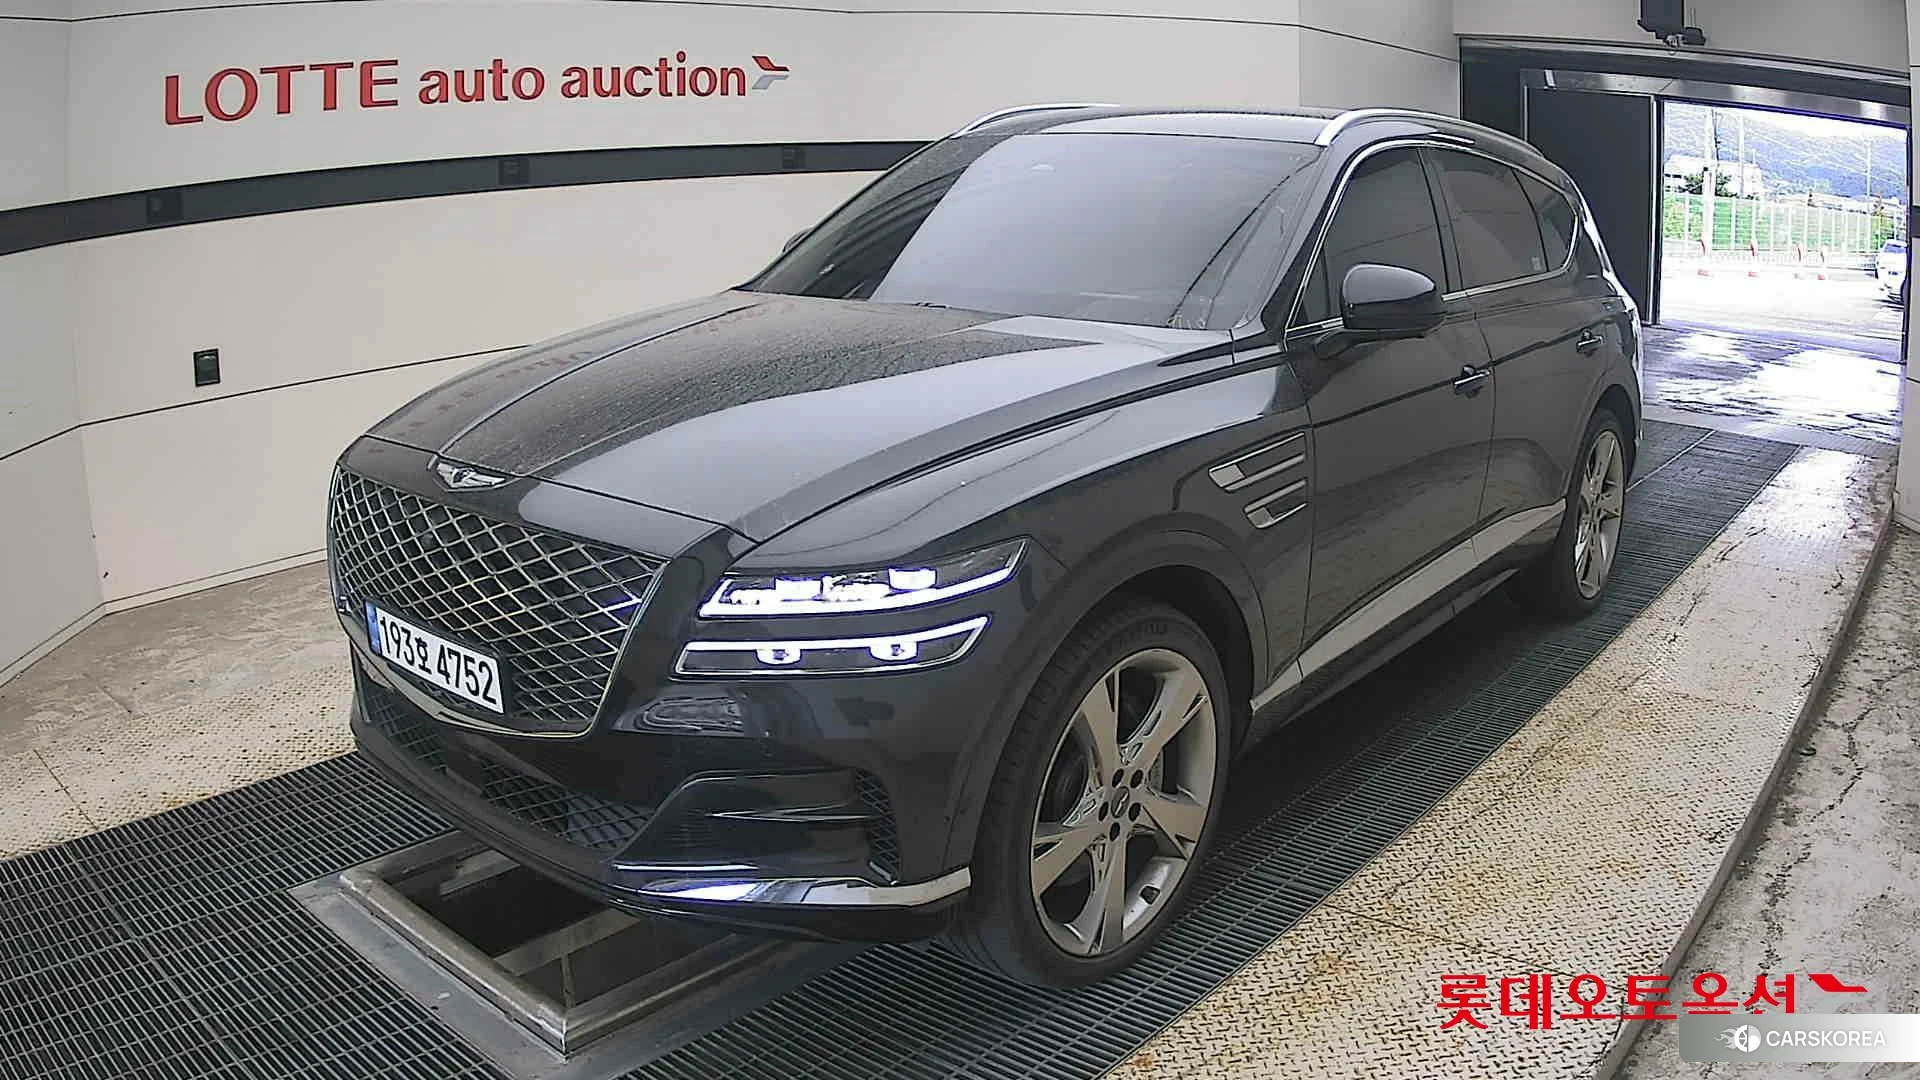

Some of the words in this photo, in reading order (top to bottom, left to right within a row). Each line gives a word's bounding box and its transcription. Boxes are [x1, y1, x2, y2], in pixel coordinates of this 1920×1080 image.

[164, 59, 399, 125] LOTTE
[418, 58, 545, 104] auto
[561, 50, 746, 99] auction
[437, 644, 497, 705] 4752
